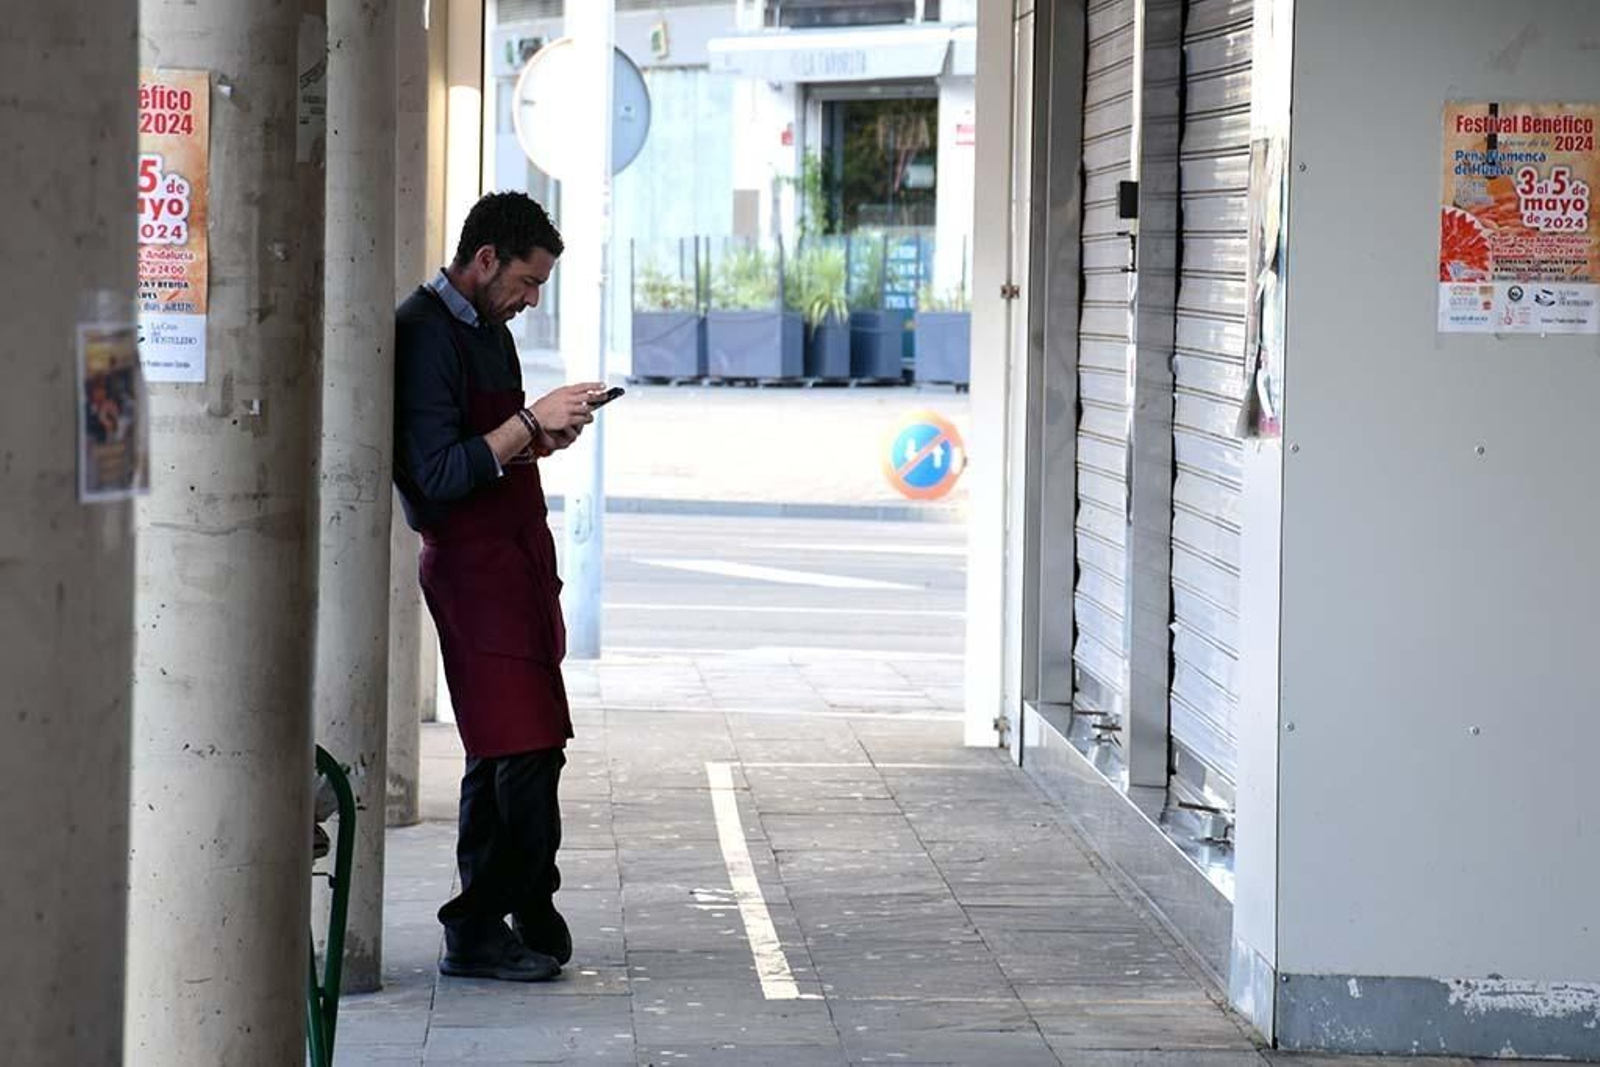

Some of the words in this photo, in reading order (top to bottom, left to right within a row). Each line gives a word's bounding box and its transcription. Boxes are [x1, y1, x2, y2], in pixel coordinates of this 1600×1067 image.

[139, 113, 193, 135] 2024
[1456, 115, 1517, 134] Festival
[1522, 115, 1593, 134] Benéfico
[1555, 136, 1593, 152] 2024
[139, 160, 157, 193] 5
[166, 179, 185, 194] de
[1520, 169, 1535, 195] 3
[1537, 183, 1548, 195] al
[1552, 170, 1567, 195] 5
[1572, 185, 1586, 196] de
[1524, 198, 1585, 215] mayo
[1526, 213, 1540, 224] de
[1543, 218, 1584, 229] 2024
